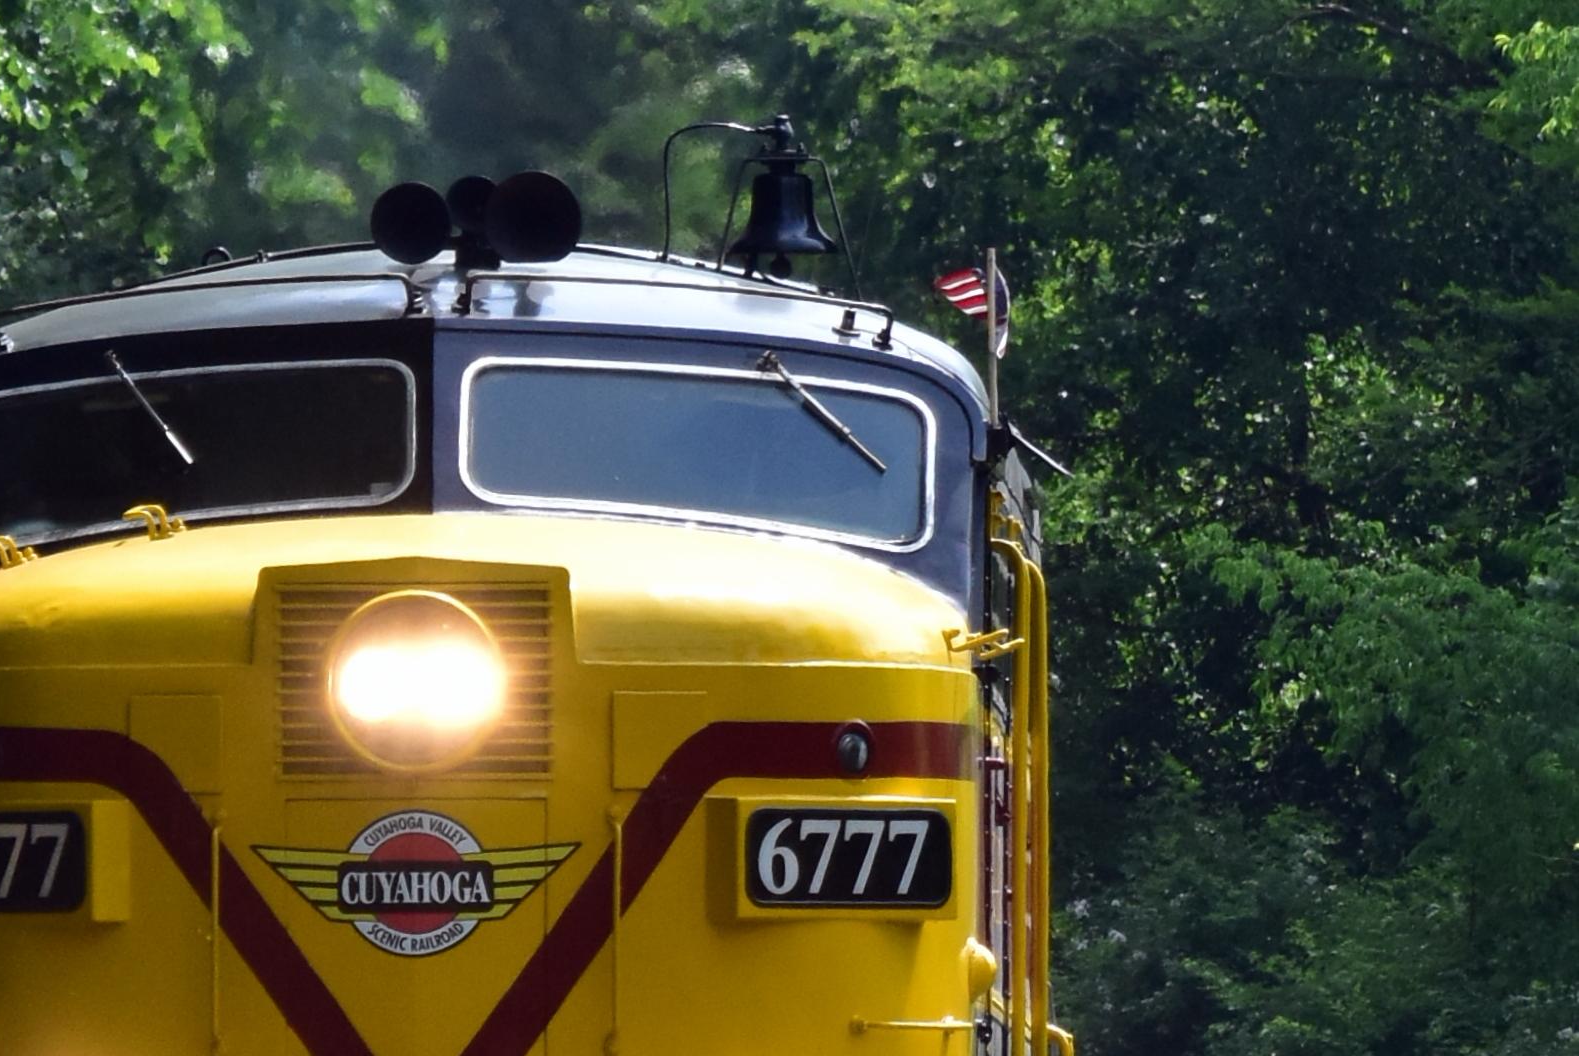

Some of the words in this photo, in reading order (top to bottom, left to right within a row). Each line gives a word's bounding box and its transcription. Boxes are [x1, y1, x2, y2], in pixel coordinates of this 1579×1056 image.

[364, 816, 423, 846] CUYAHOGA
[429, 817, 467, 846] VALLEY
[758, 817, 929, 895] 6777
[342, 871, 490, 904] CUYAHOGA
[367, 923, 407, 952] SCENIC
[410, 922, 464, 951] RAILROAD
